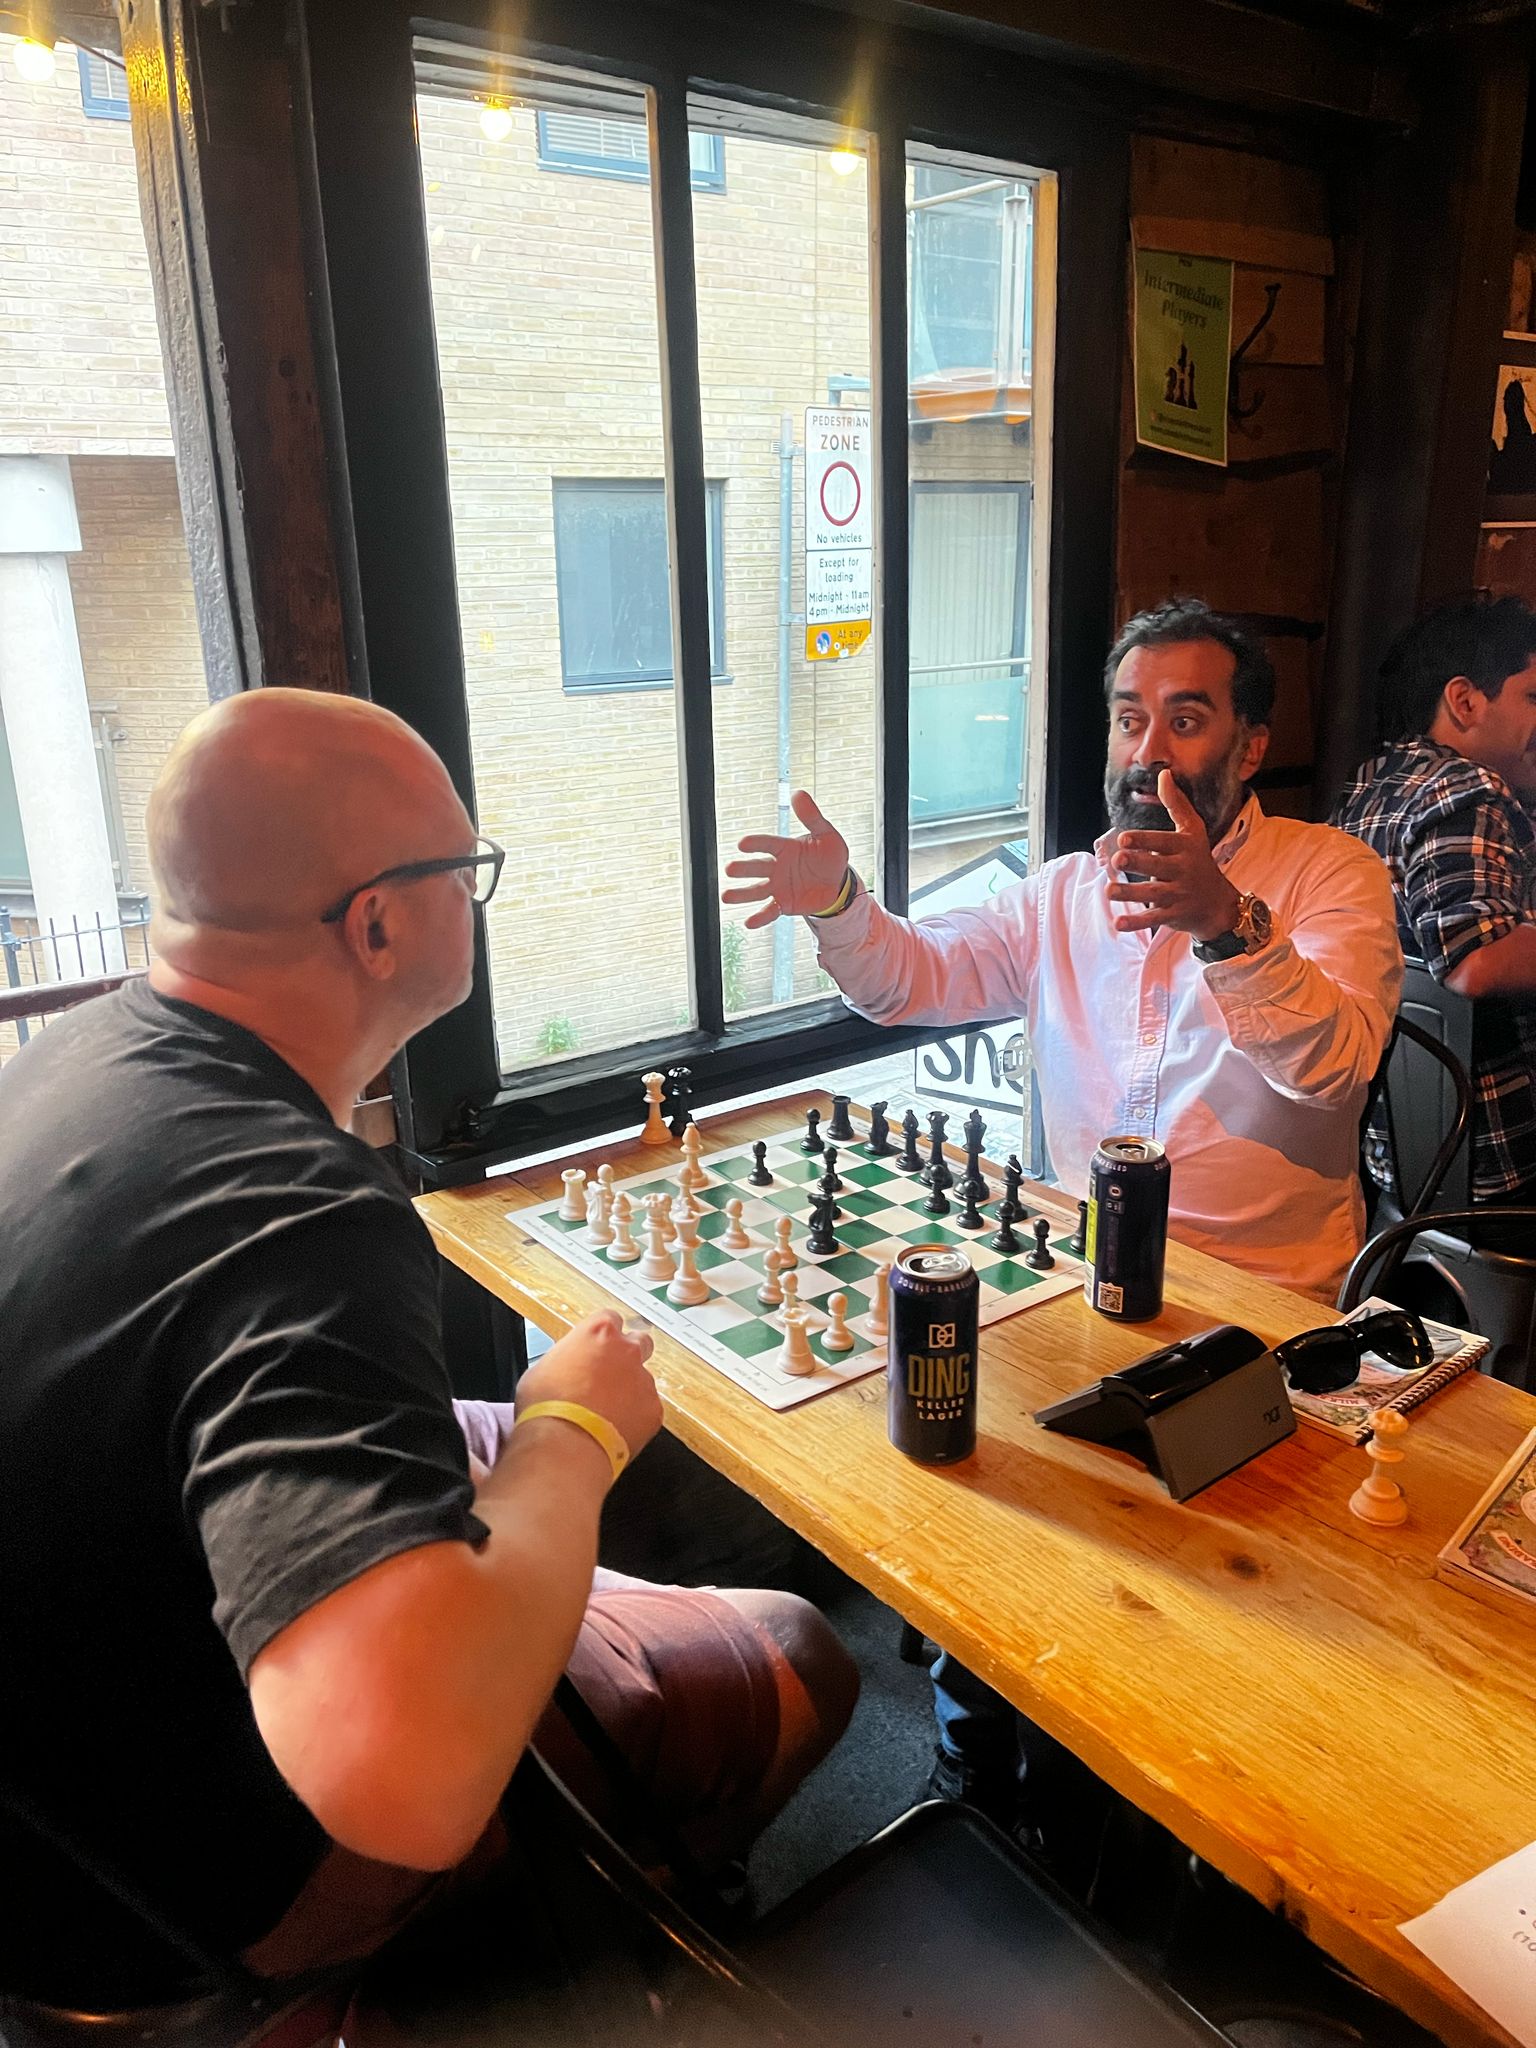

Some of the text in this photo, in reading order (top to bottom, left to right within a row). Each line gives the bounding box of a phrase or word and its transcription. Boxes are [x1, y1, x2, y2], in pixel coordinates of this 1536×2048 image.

[1161, 299, 1208, 327] Players
[812, 415, 869, 428] PEDESTRIAN
[820, 434, 860, 451] ZONE
[816, 532, 862, 544] No vehicles
[819, 556, 860, 569] Except for
[825, 572, 854, 583] loading
[808, 591, 843, 603] Midnight
[836, 602, 869, 615] Midnight
[908, 1353, 971, 1400] DING
[916, 1397, 965, 1410] KELLER
[919, 1408, 962, 1421] LAGER
